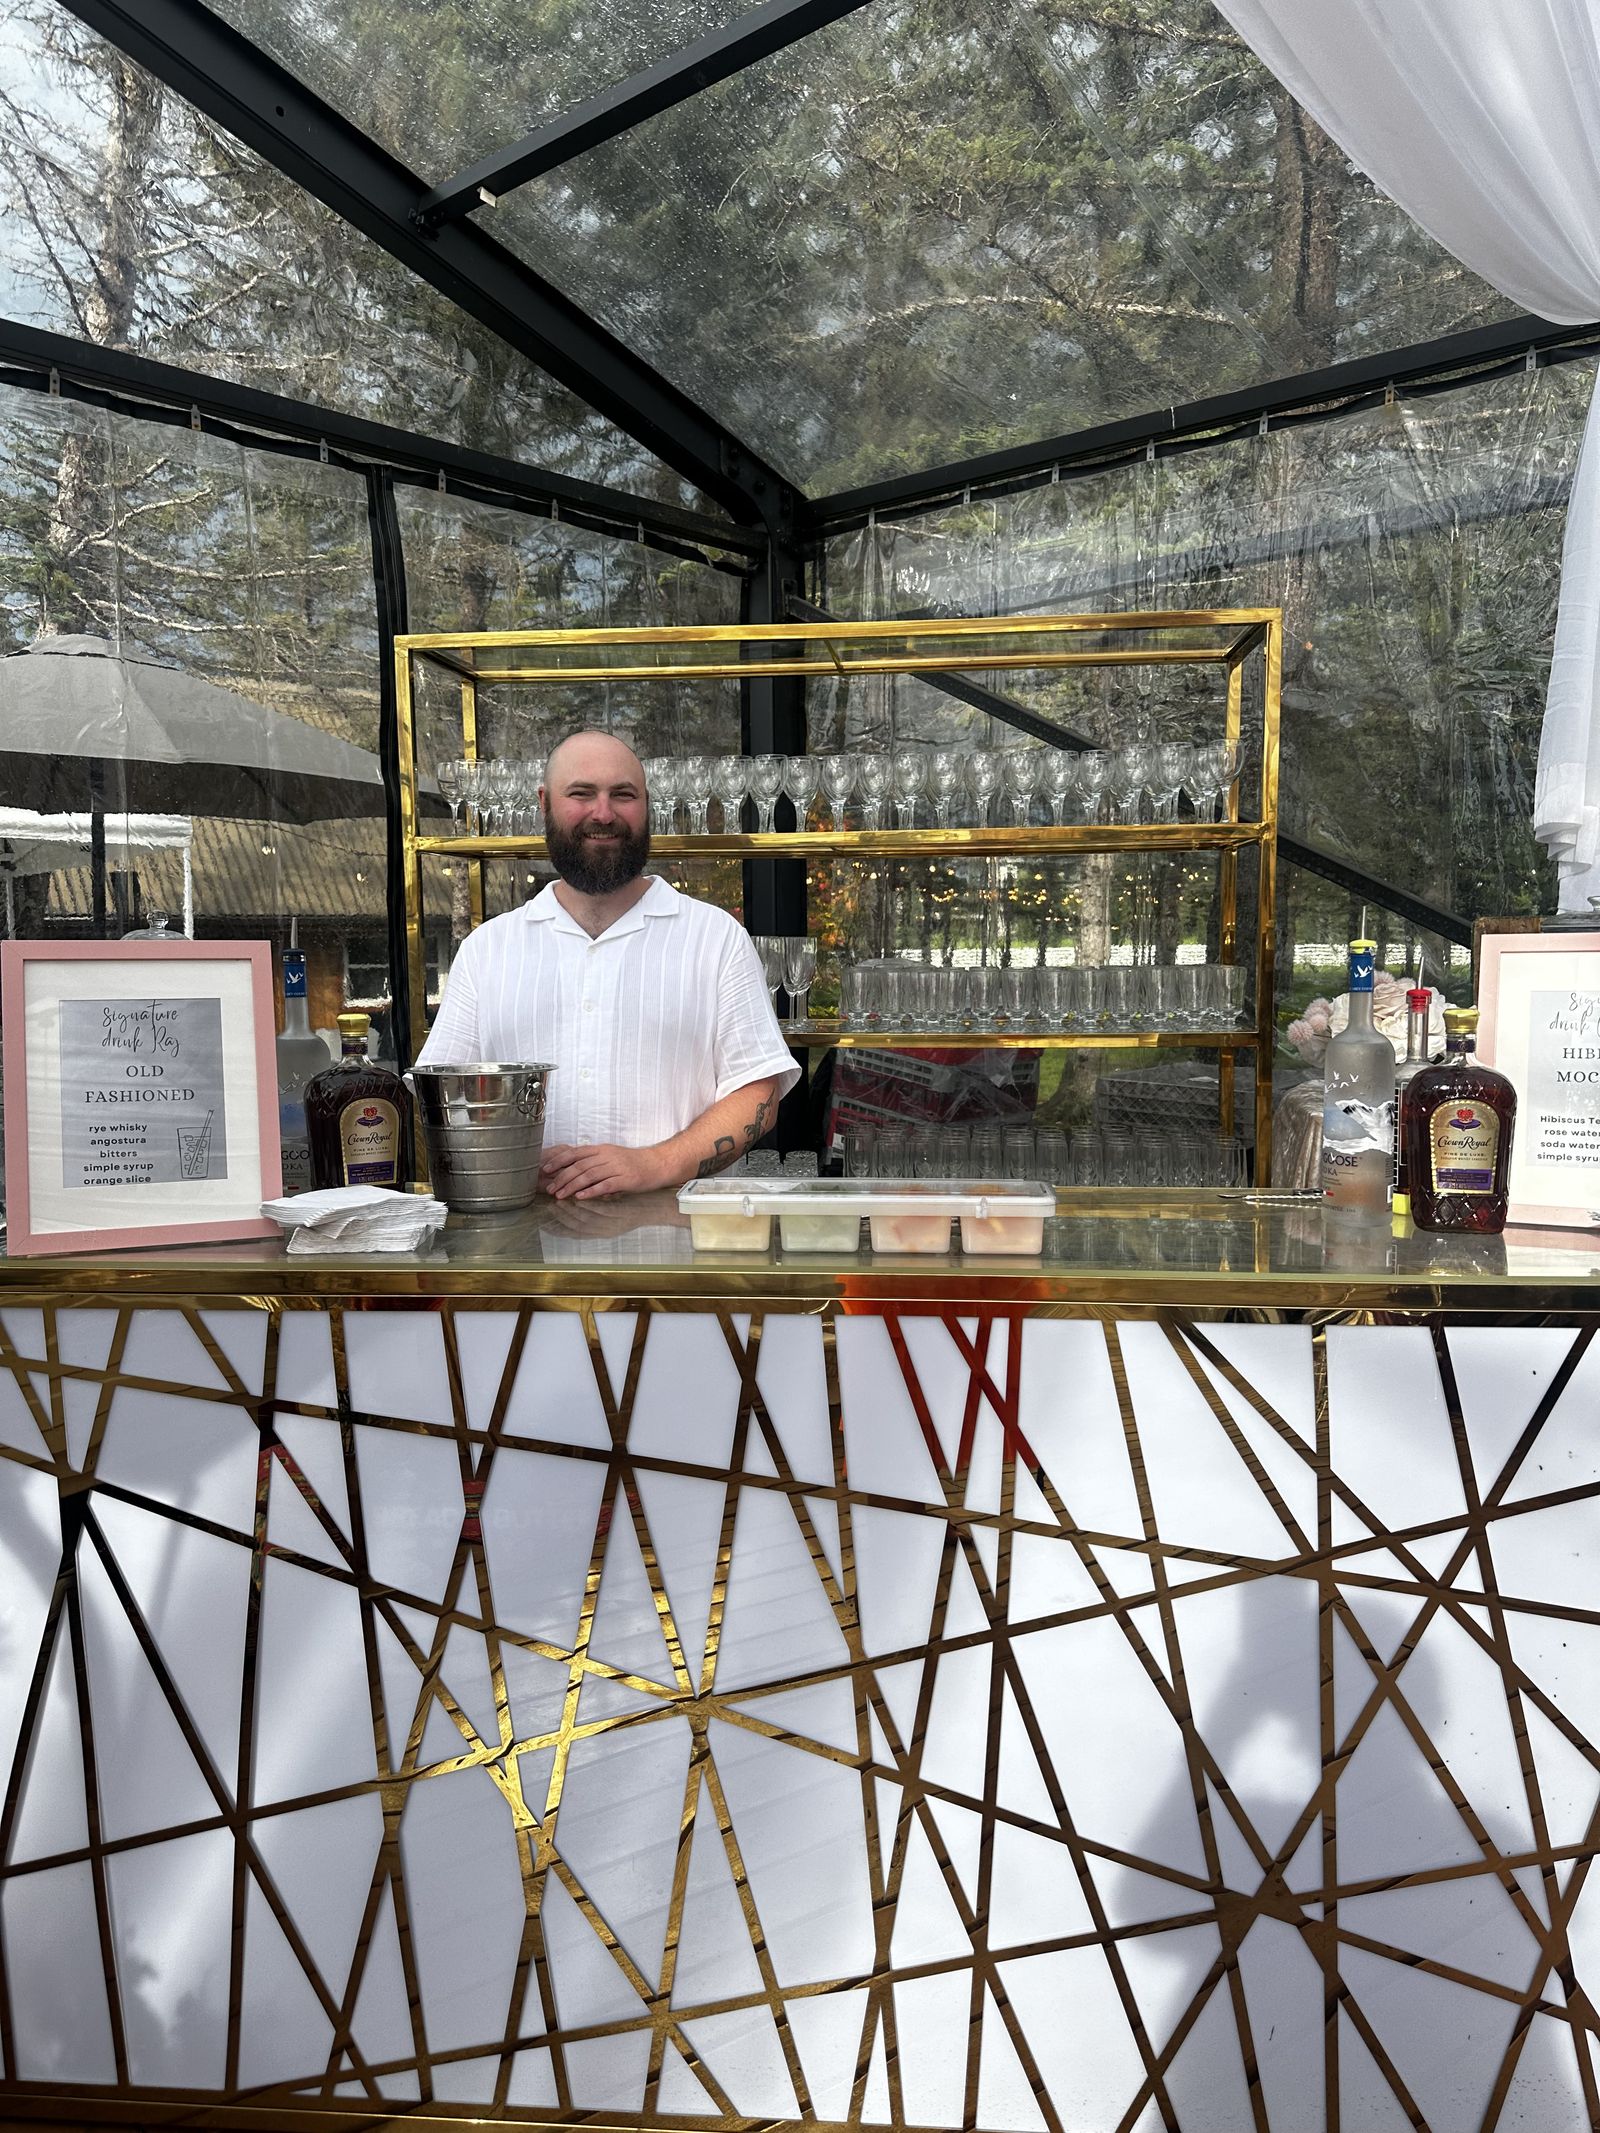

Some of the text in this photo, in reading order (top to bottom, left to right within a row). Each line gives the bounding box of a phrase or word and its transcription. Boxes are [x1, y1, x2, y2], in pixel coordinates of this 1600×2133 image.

[102, 1000, 179, 1033] Signature
[1549, 1010, 1590, 1035] drink
[101, 1027, 144, 1053] drink
[126, 1065, 164, 1078] OLD
[85, 1089, 195, 1103] FASHIONED
[1540, 1115, 1586, 1125] Hibiscus
[89, 1123, 148, 1134] rye whisky
[90, 1137, 147, 1146] angostura
[347, 1131, 393, 1146] Crown Royal
[1437, 1135, 1492, 1150] Crown Royal
[1569, 1142, 1600, 1150] water
[100, 1150, 138, 1158] bitters
[1322, 1152, 1359, 1167] GOOSE
[1537, 1152, 1573, 1162] simple
[83, 1163, 154, 1173] simple syrup
[83, 1175, 152, 1185] orange slice
